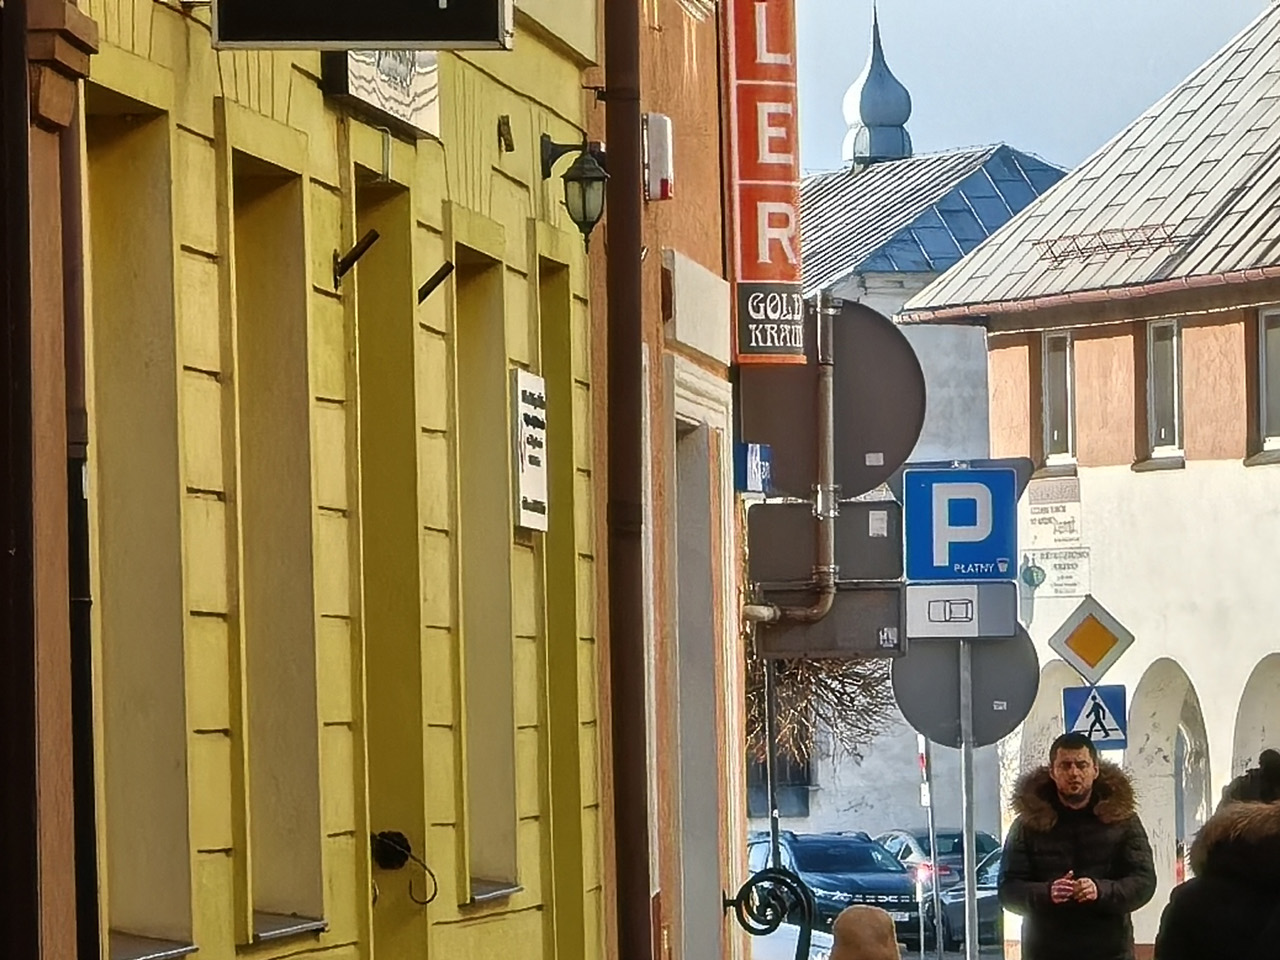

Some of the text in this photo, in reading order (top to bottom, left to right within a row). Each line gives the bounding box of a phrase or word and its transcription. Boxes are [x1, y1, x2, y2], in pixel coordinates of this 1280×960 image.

[748, 292, 804, 320] GOLD
[932, 482, 992, 567] P
[953, 563, 995, 574] PŁATNY
